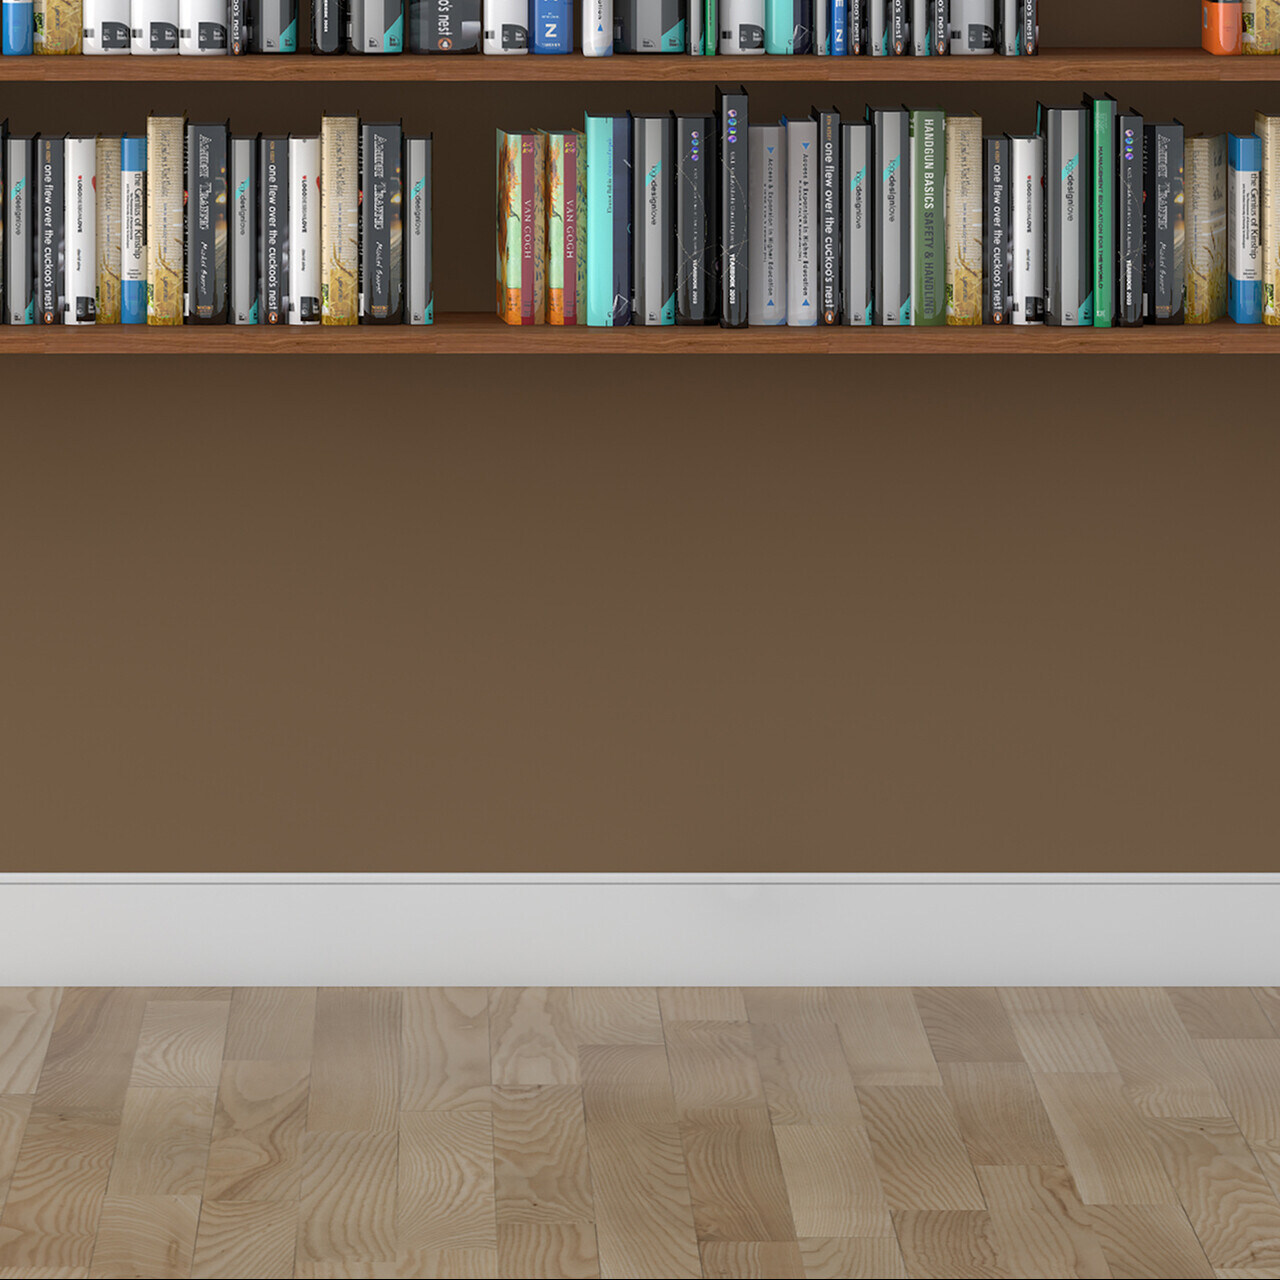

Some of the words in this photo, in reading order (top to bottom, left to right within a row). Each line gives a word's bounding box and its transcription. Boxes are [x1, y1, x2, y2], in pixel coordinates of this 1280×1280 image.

[438, 15, 452, 35] nest
[924, 119, 934, 169] HANDGUN
[135, 173, 143, 187] the
[825, 166, 834, 187] flew
[135, 188, 143, 216] Genius
[924, 173, 934, 209] BASICS
[135, 218, 143, 228] of
[825, 217, 834, 233] the
[925, 212, 934, 248] SAFETY
[1251, 218, 1258, 228] of
[133, 229, 143, 260] Kinship
[1249, 229, 1258, 260] Kinship
[825, 237, 834, 282] cuckoo's
[825, 286, 834, 307] nest
[924, 263, 934, 314] HANDLING
